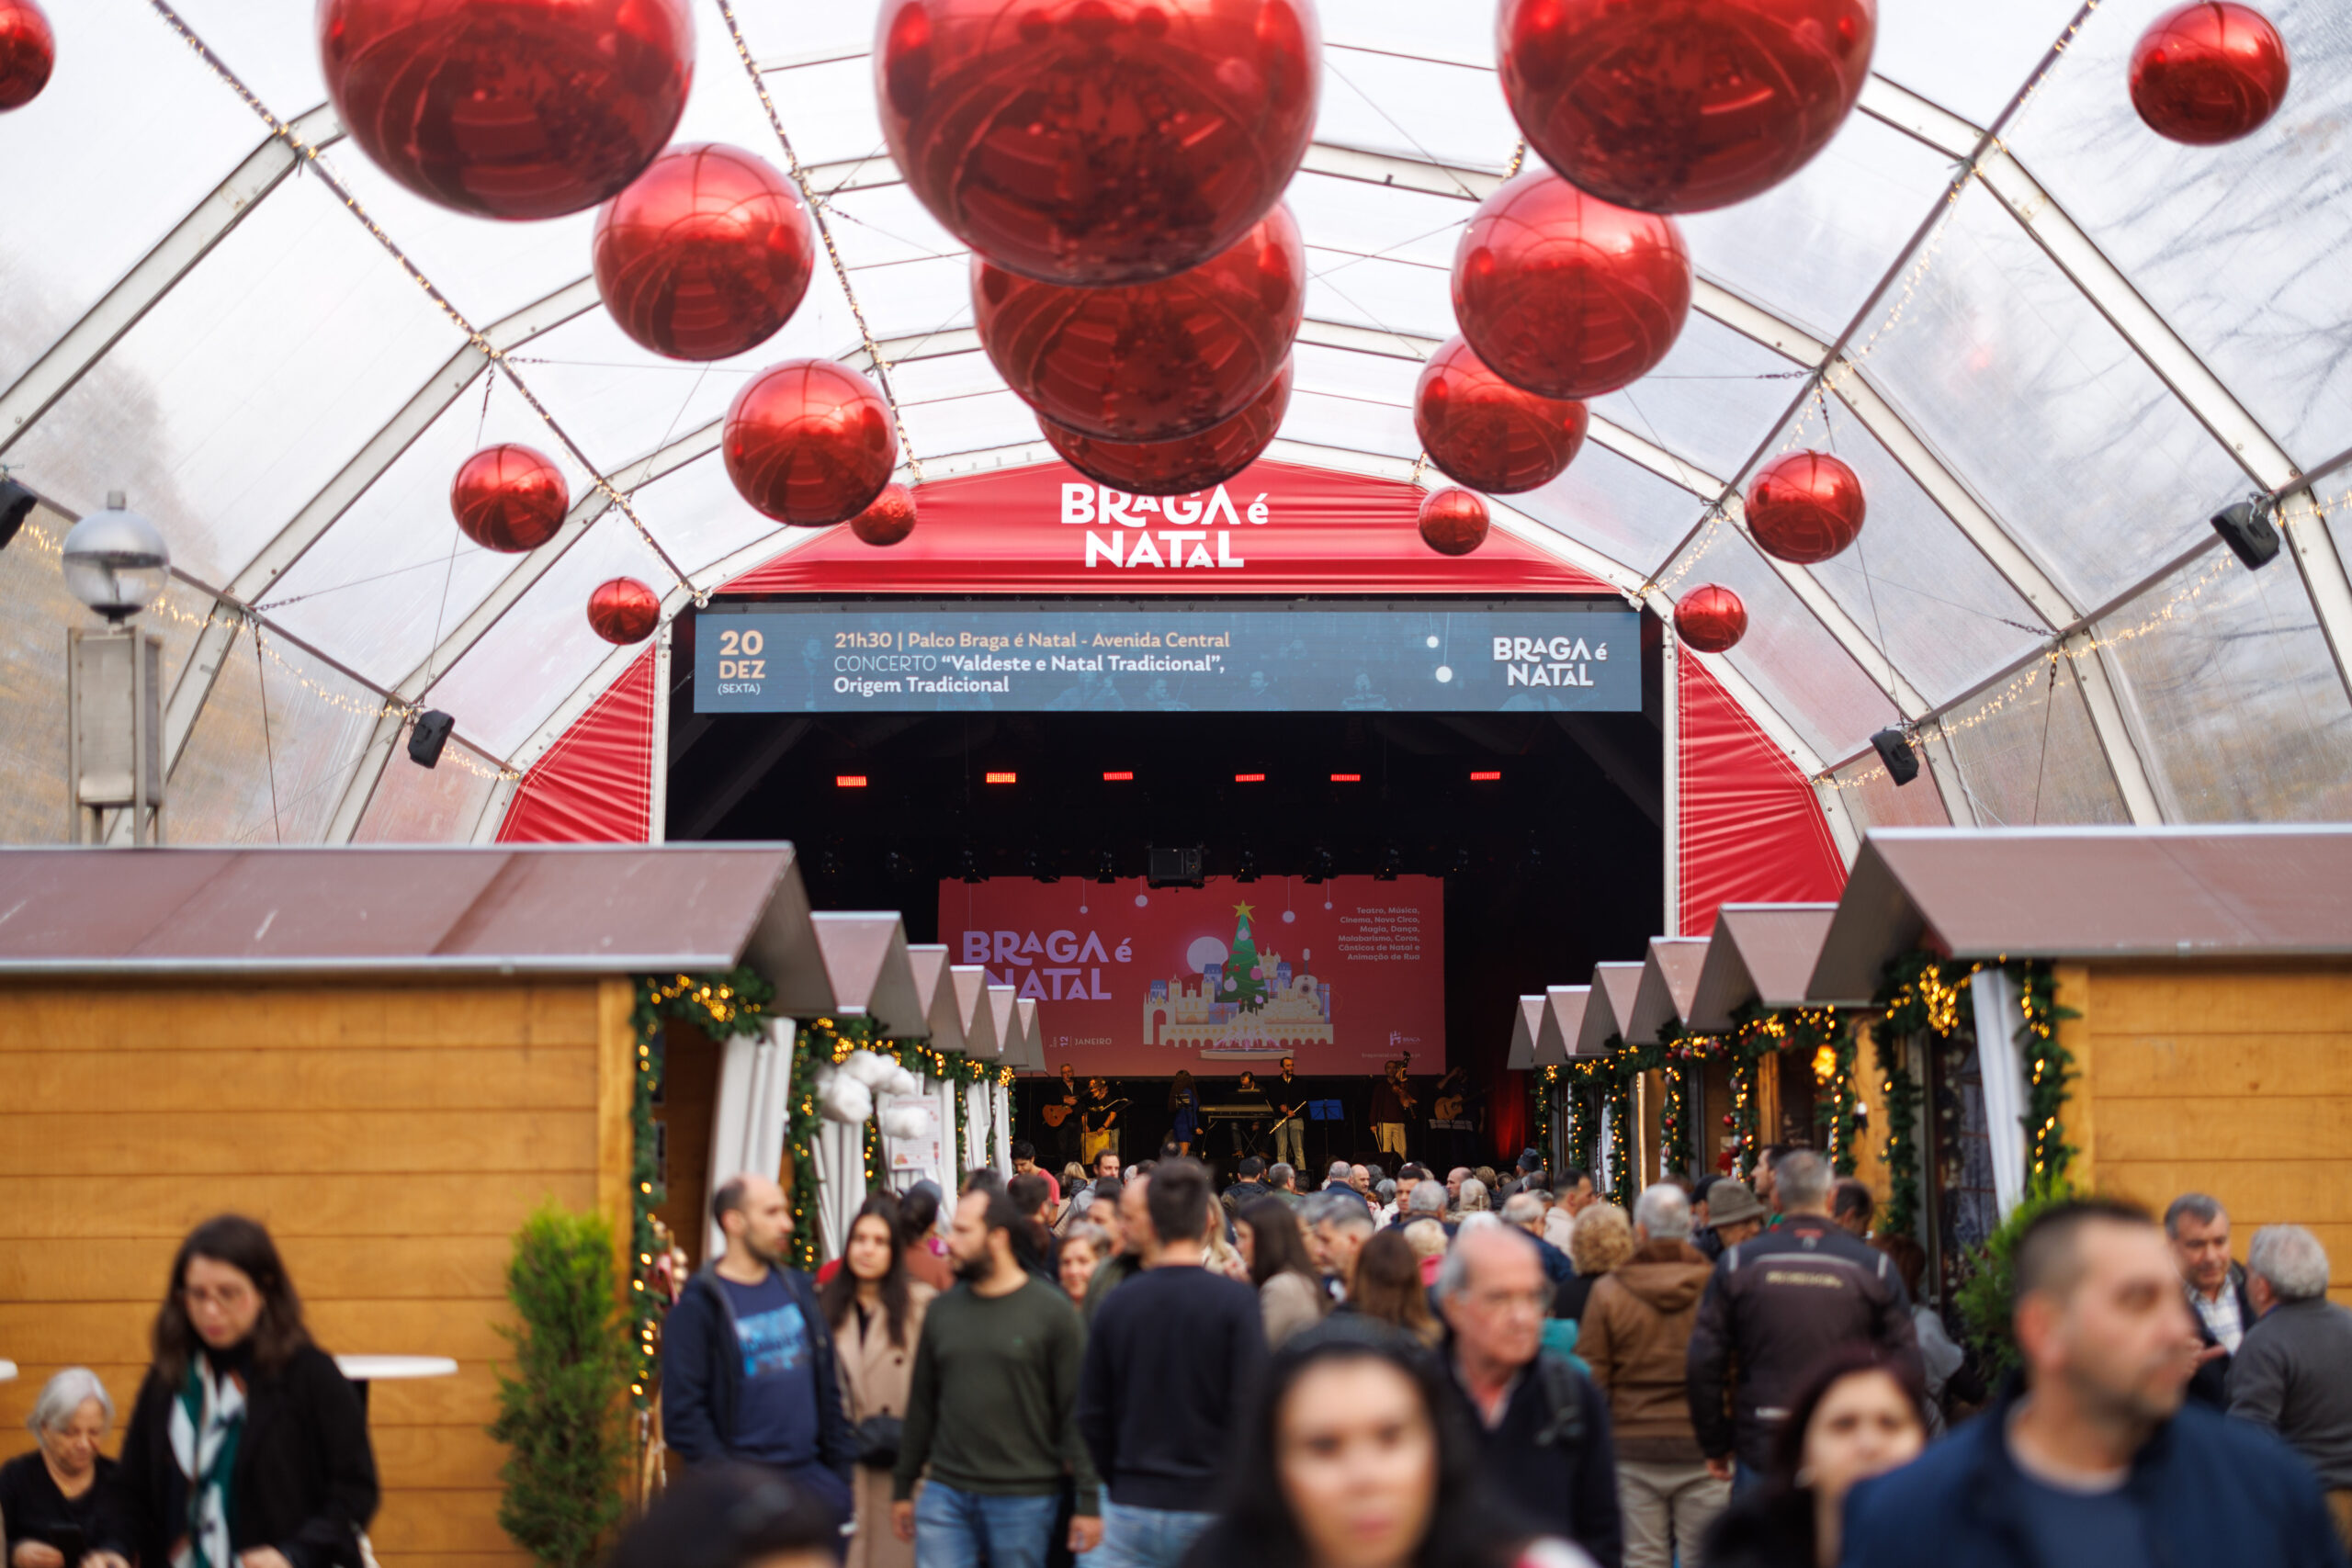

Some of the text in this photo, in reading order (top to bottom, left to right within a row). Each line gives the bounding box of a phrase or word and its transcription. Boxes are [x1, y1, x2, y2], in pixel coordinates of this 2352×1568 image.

[1061, 483, 1269, 527] BRAGA é
[1085, 530, 1244, 568] NATAL
[719, 630, 763, 656] 20
[835, 632, 892, 649] 21h30
[908, 632, 956, 648] Palco
[959, 633, 1010, 651] Braga
[1013, 633, 1023, 648] é
[1028, 632, 1077, 648] Natal
[1092, 632, 1161, 648] Avenida
[1165, 632, 1230, 648] Central
[1493, 637, 1608, 662] BRAGA é
[719, 660, 765, 679] DEZ
[834, 655, 936, 671] CONCERTO
[1035, 660, 1046, 671] e
[1051, 655, 1103, 671] Natal
[1507, 663, 1594, 686] NATAL
[718, 682, 761, 695] (SEXTA)
[833, 675, 1010, 697] Origem Tradicional
[963, 930, 1133, 966] BRAGA é
[1347, 953, 1389, 962] Animação
[1074, 1037, 1112, 1045] JANEIRO
